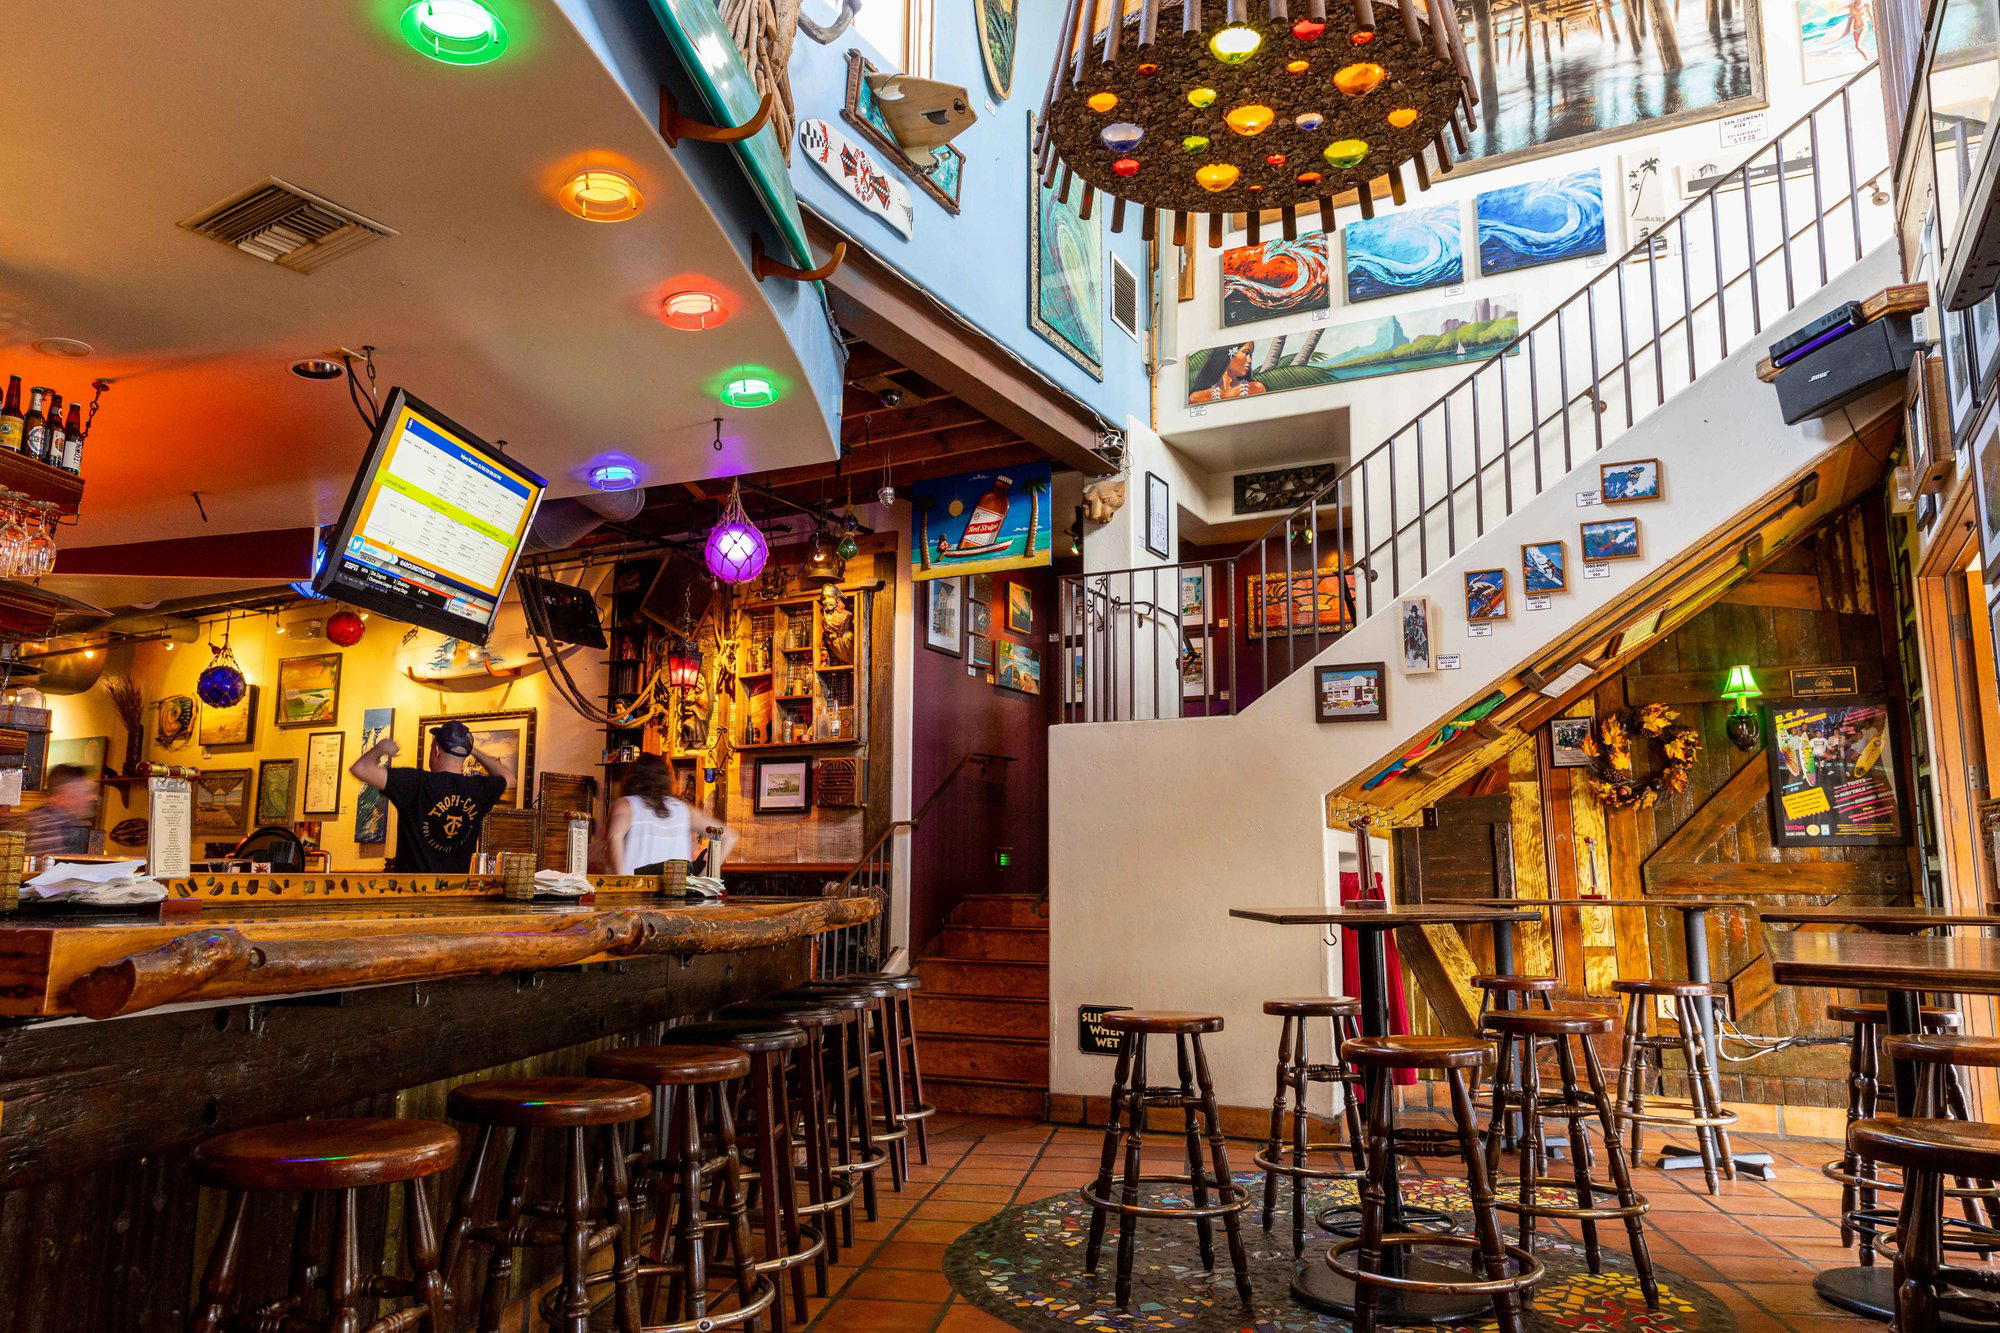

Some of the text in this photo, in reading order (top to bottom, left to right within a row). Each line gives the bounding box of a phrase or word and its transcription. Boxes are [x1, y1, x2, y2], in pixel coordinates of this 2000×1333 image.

[1808, 370, 1831, 383] BOSE
[1082, 1012, 1103, 1023] SLIP
[1095, 1037, 1120, 1048] WET
